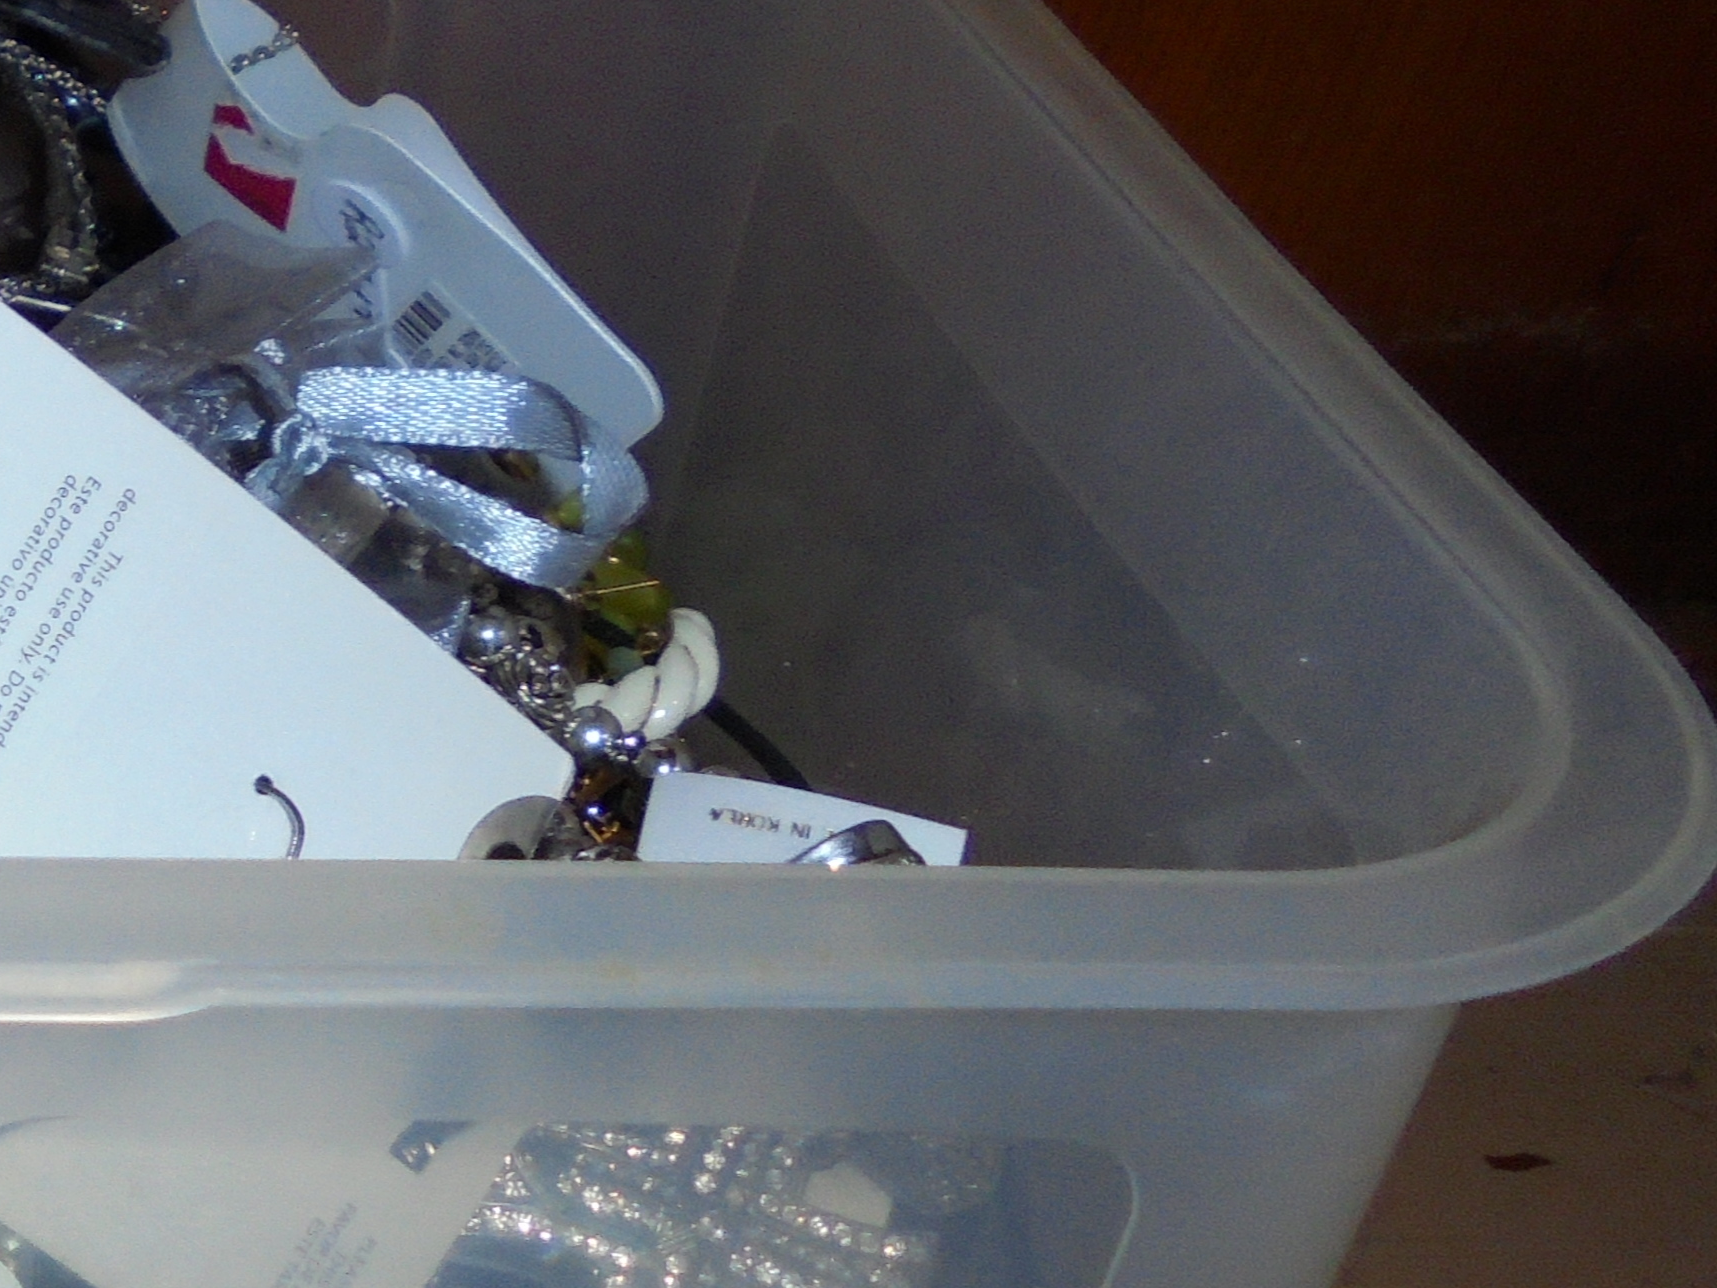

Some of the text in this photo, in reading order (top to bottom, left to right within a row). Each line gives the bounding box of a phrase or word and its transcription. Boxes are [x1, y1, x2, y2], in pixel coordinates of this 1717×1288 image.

[69, 476, 102, 515] Este
[11, 474, 77, 571] decorativo
[71, 488, 136, 584] decorative
[15, 515, 73, 602] producto
[91, 551, 124, 587] This
[48, 587, 75, 619] use
[18, 622, 52, 665] only.
[37, 587, 95, 664] product
[0, 669, 26, 697] Do
[31, 665, 51, 683] is
